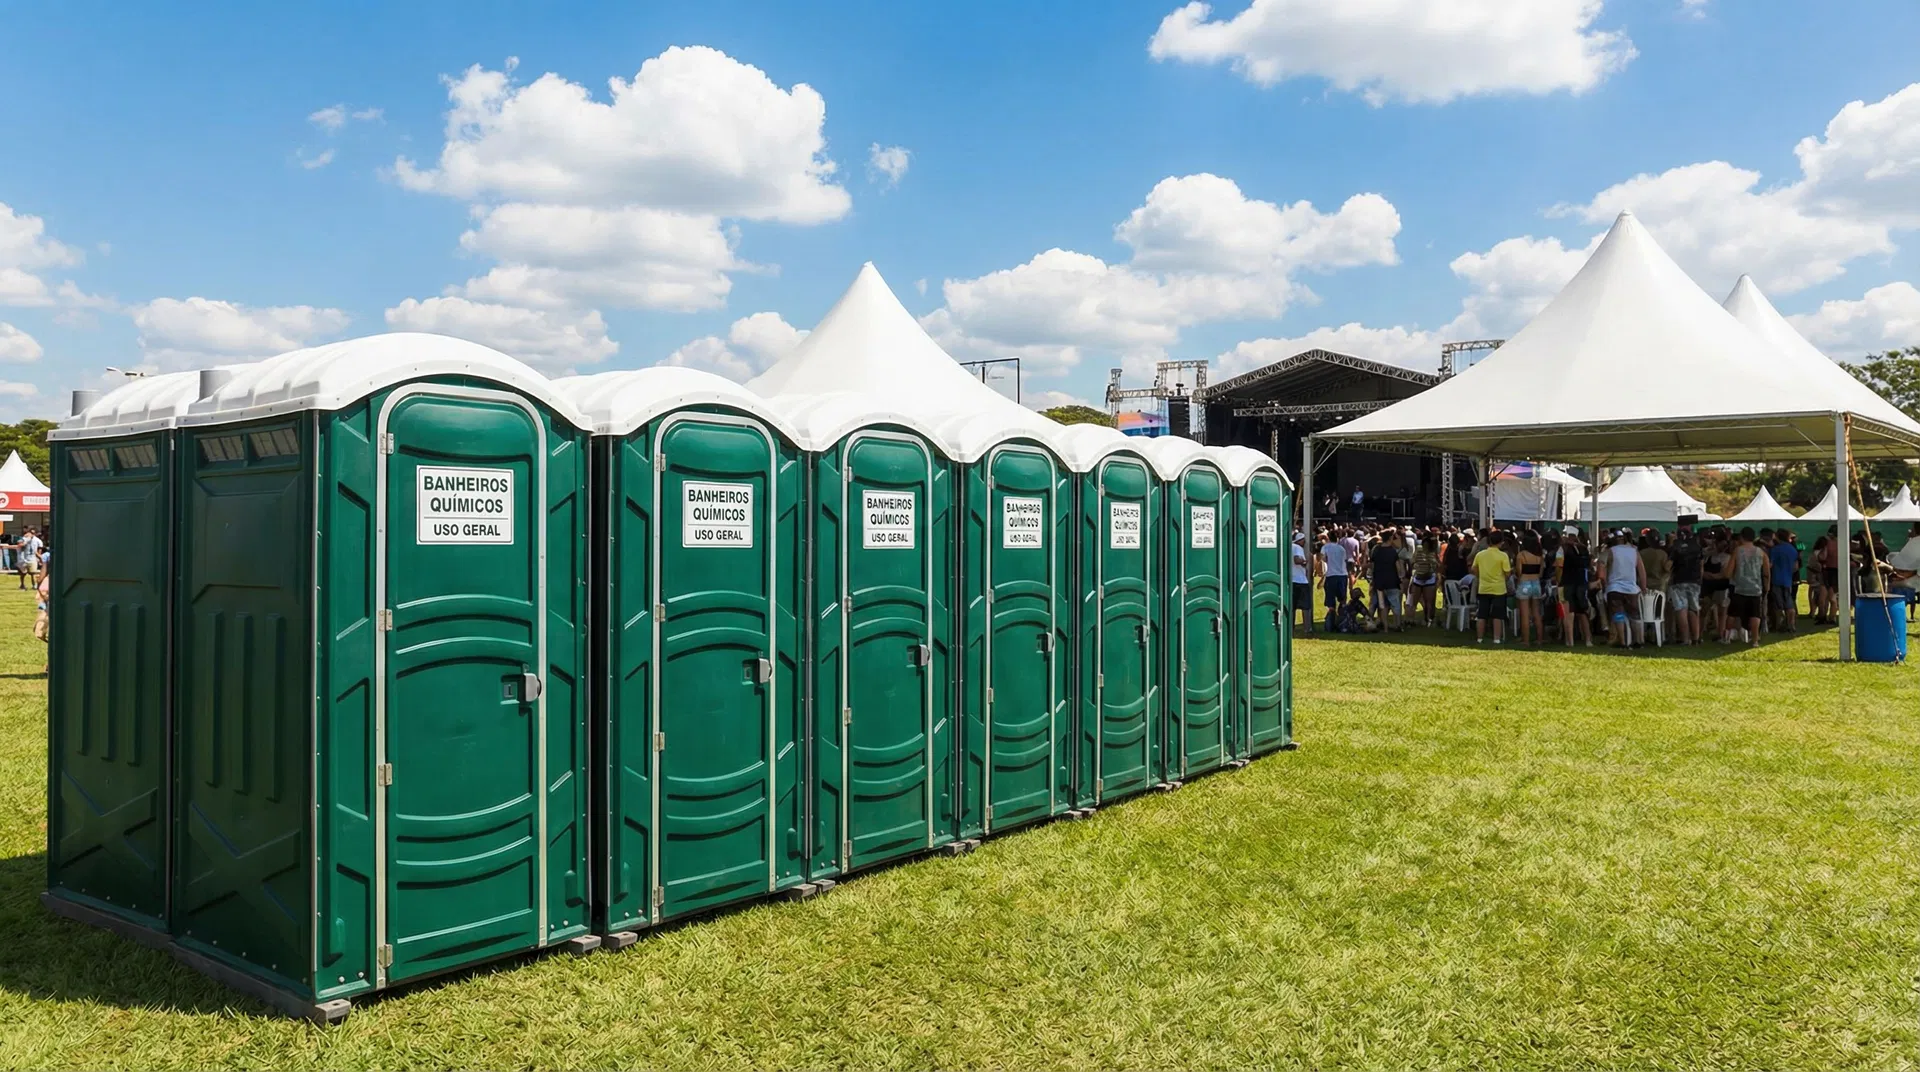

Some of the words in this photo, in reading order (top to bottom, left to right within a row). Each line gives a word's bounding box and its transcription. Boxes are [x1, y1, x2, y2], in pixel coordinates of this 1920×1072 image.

[424, 476, 508, 492] BANHEIROS
[430, 493, 503, 513] QUÍMICOS
[688, 489, 749, 504] BANHEIROS
[867, 498, 913, 510] BANHEIROS
[693, 504, 746, 521] QUÍMICOS
[434, 524, 459, 536] USO
[463, 524, 501, 536] GERAL
[694, 529, 714, 540] USO
[716, 530, 744, 540] GERAL
[872, 533, 886, 543] USO
